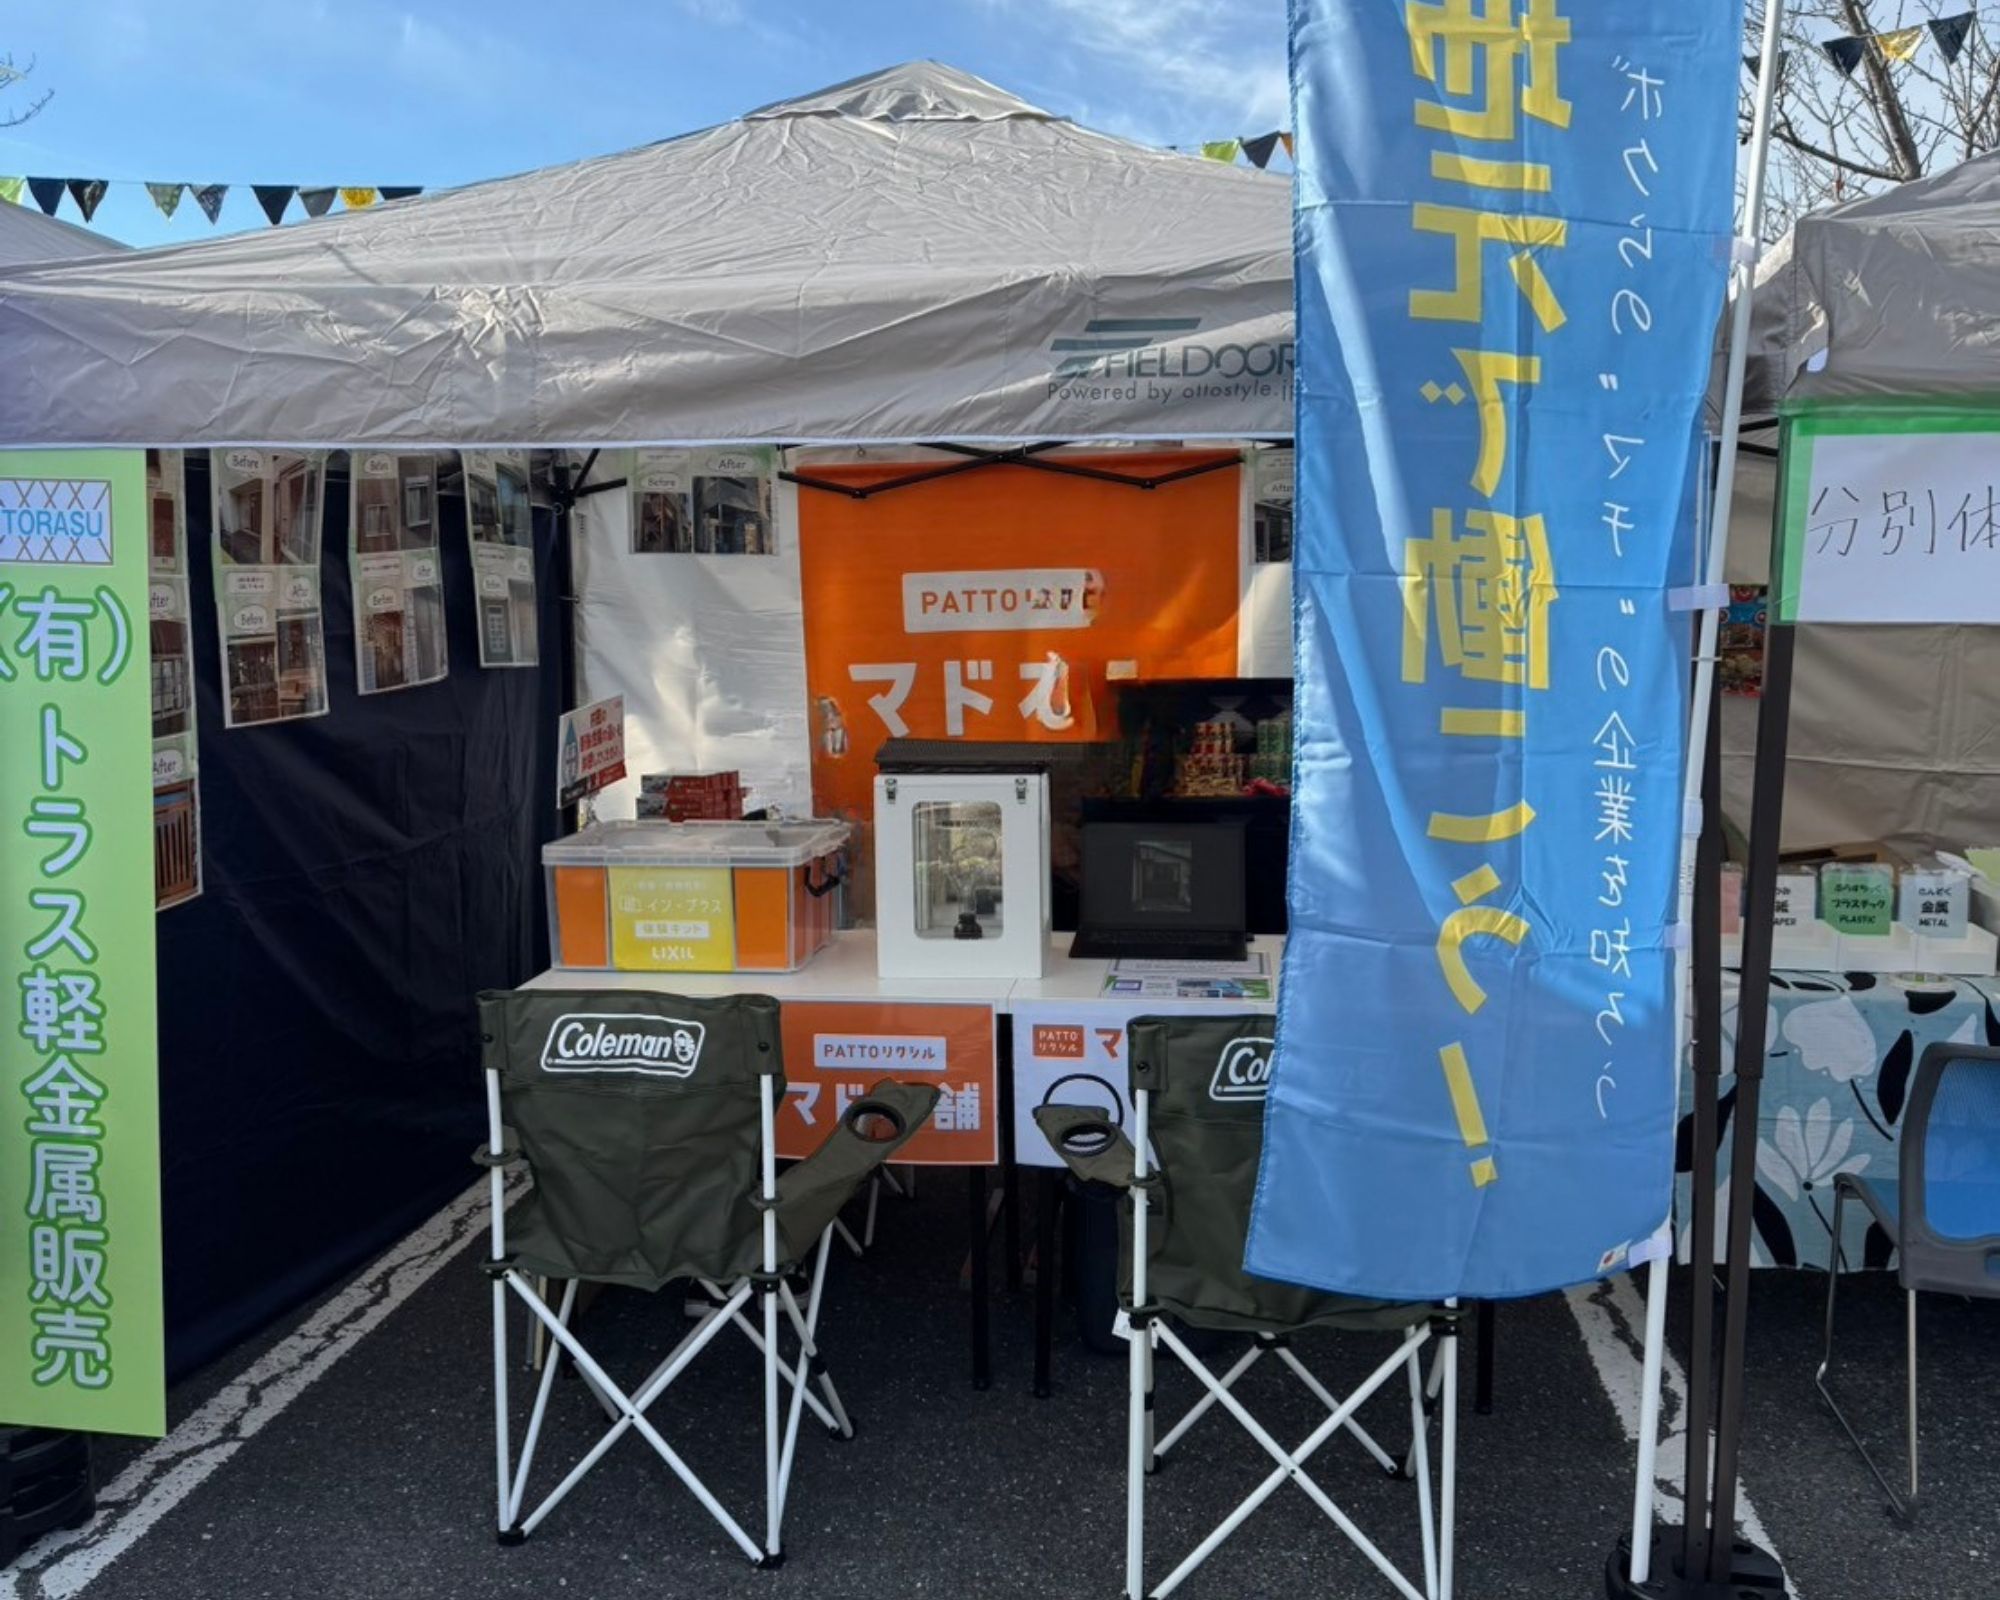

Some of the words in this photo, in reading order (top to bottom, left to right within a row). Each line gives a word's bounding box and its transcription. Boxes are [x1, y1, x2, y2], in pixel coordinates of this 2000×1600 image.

[1104, 343, 1295, 378] FIELDOOR
[1048, 382, 1137, 400] Powered
[1148, 382, 1174, 404] by
[2, 508, 103, 538] TORASU
[1921, 901, 1949, 914] 金属
[1774, 917, 1797, 926] APER
[1838, 914, 1877, 925] PLASTIC
[1918, 918, 1949, 927] METAL
[651, 946, 695, 961] LIXIL
[557, 1022, 672, 1058] Coleman
[1039, 1031, 1079, 1041] PATTO
[786, 1081, 981, 1131] マド舗
